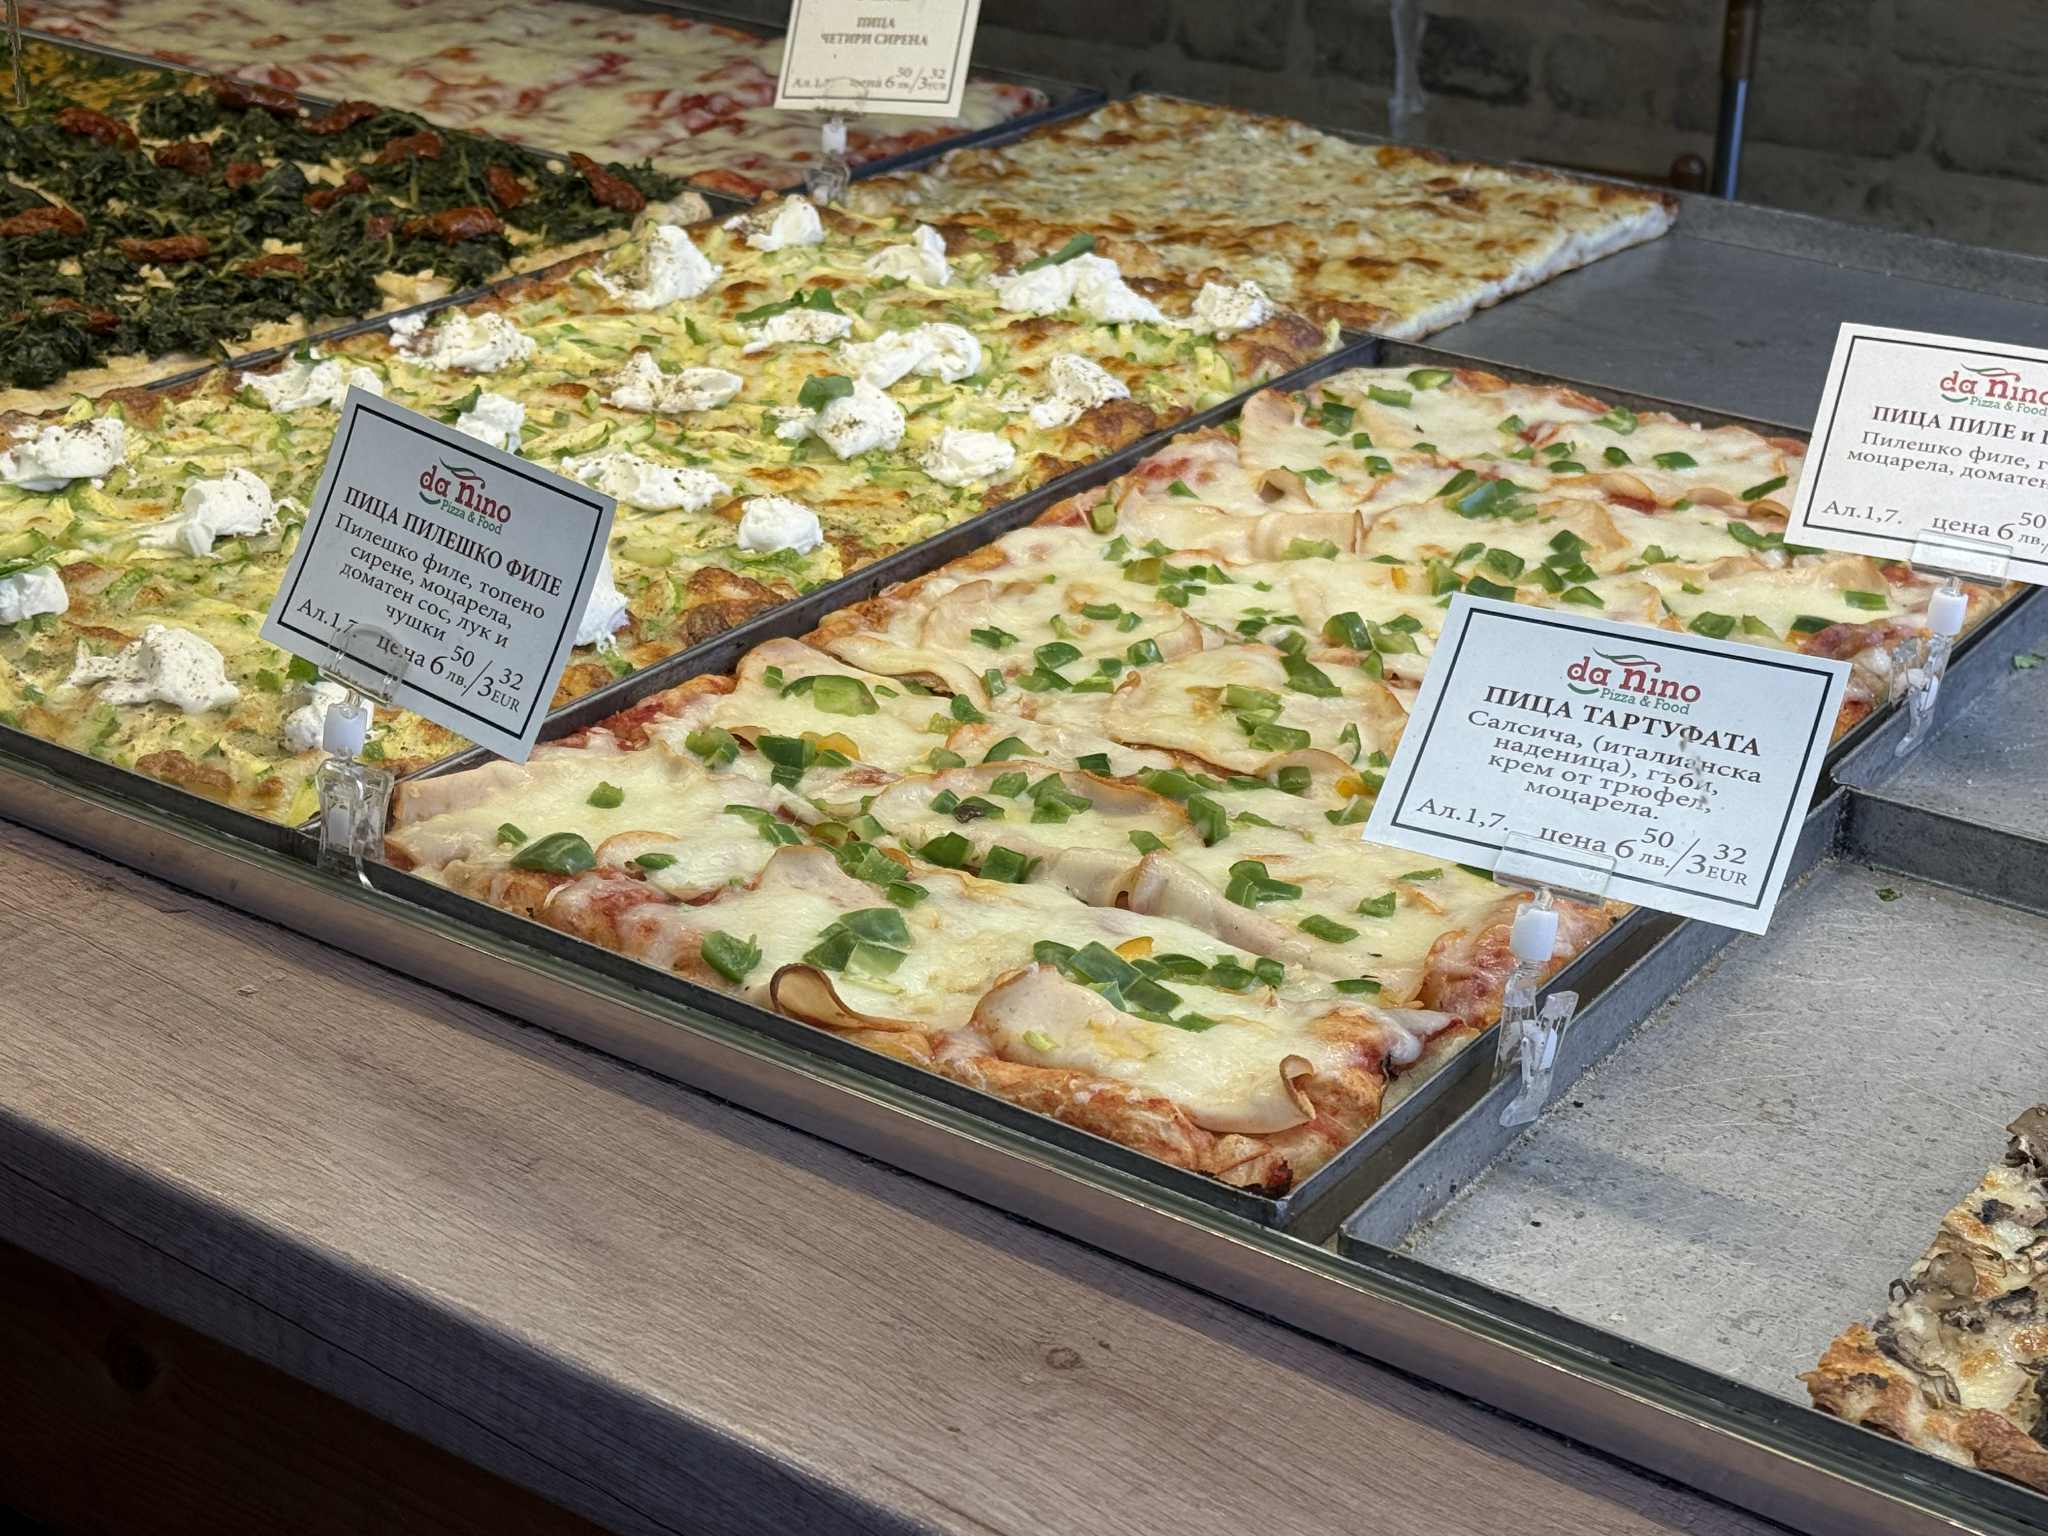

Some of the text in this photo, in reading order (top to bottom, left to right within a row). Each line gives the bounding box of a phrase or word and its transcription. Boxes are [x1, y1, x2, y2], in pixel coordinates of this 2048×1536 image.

[1939, 370, 1978, 394] da
[1969, 396, 2001, 409] Pizza
[2016, 403, 2048, 416] Food
[1872, 406, 1941, 430] ПИЦА
[1948, 416, 2016, 440] ПИЛЕ
[2021, 431, 2035, 442] и
[1847, 450, 1955, 475] моцарела,
[1861, 431, 1963, 457] Пилешко
[1968, 446, 2030, 469] филе,
[420, 464, 451, 498] da
[440, 500, 466, 520] Pizza
[477, 515, 503, 535] Food
[1932, 518, 1990, 536] цена
[1997, 523, 2016, 540] 6
[2018, 512, 2047, 529] 50
[343, 486, 563, 597] ПИЦА ПИЛЕШКО ФИЛЕ
[335, 513, 545, 620] Пилешко филе, топено
[351, 546, 512, 630] сирене, моцарела,
[339, 563, 509, 648] доматен сос, лук и
[386, 604, 447, 642] чушки
[430, 655, 450, 675] 6
[450, 645, 476, 668] 50
[1567, 656, 1611, 687] da
[498, 668, 524, 691] 32
[490, 692, 521, 713] EUR
[1600, 688, 1636, 706] Pizza
[1651, 697, 1690, 716] Food
[1468, 710, 1583, 749] Салсича,
[1483, 685, 1761, 757] ПИЦА ТАРТУФАТА
[1493, 736, 1638, 780] наденица),
[1488, 754, 1713, 814] крем от трюфел,
[1523, 780, 1659, 821] моцарела.
[1538, 825, 1607, 854] цена
[1614, 838, 1637, 860] 6
[1641, 827, 1675, 849] 50
[1712, 843, 1748, 866] 32
[1705, 866, 1748, 887] EUR
